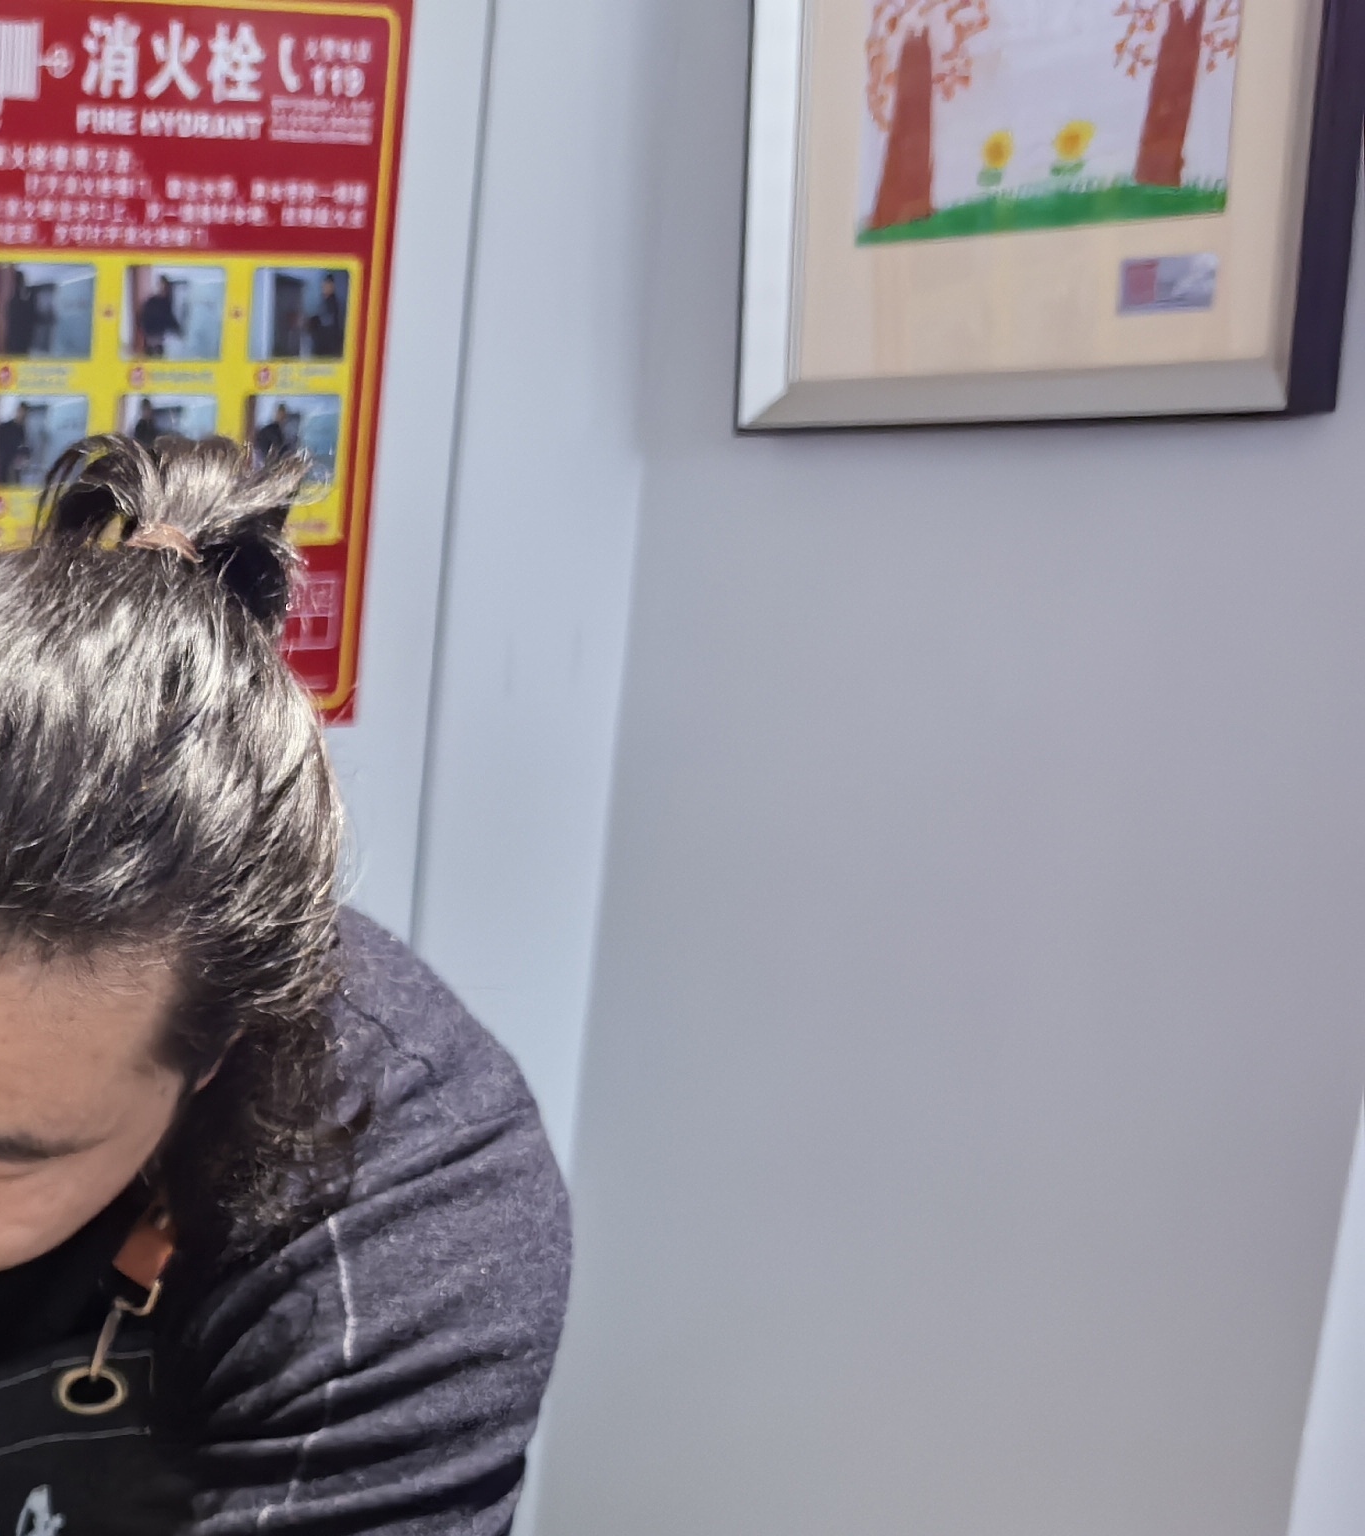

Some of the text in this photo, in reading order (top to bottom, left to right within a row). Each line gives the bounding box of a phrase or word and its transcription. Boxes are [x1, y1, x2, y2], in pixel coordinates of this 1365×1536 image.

[80, 14, 267, 103] 消火栓
[76, 104, 137, 136] FIRE
